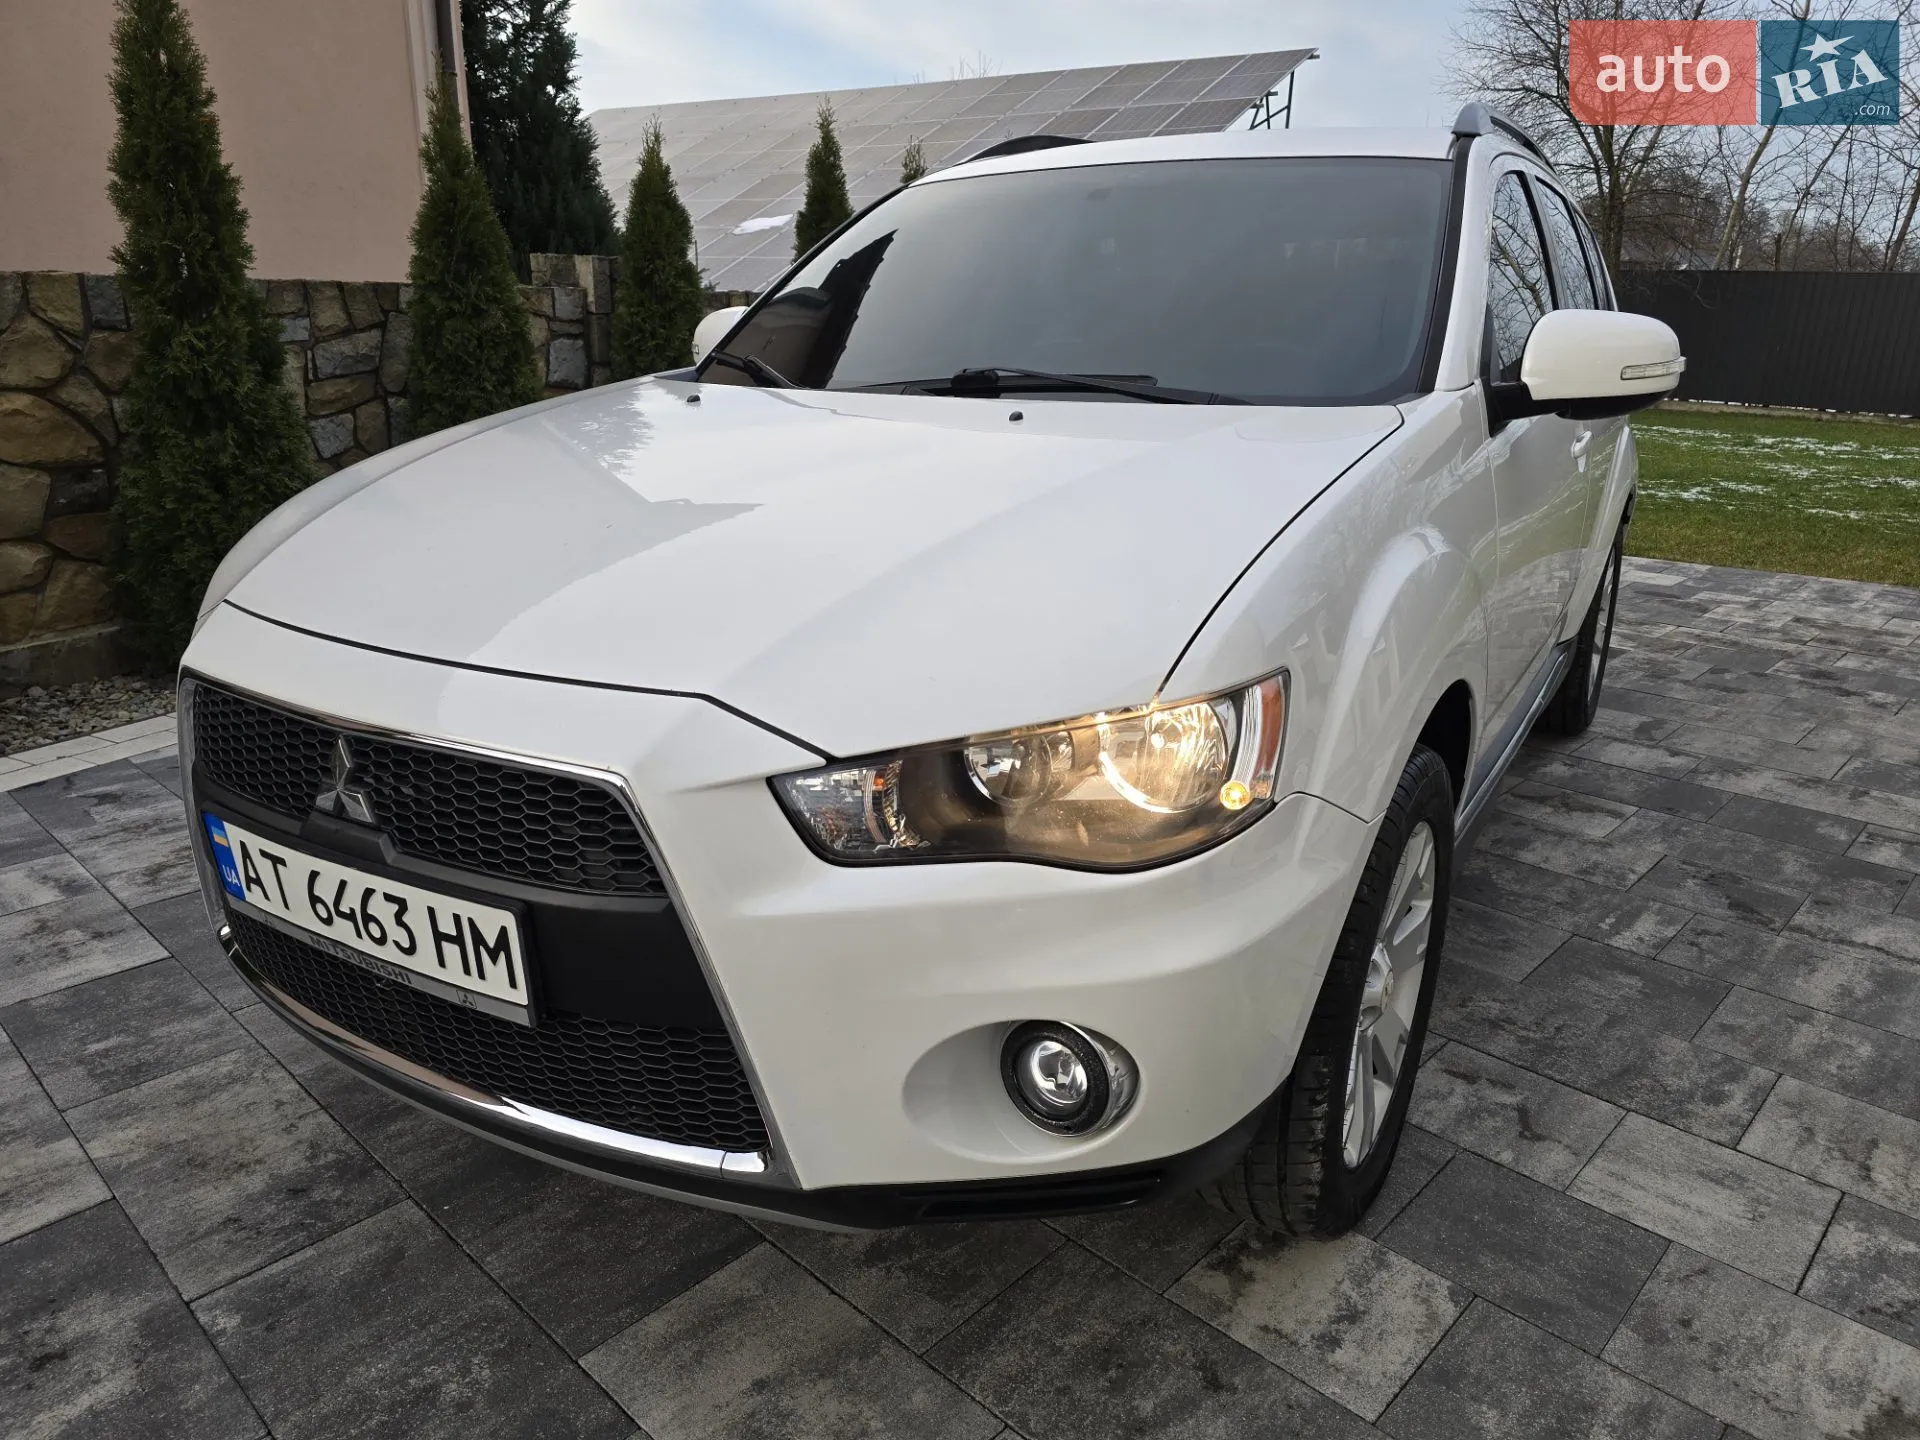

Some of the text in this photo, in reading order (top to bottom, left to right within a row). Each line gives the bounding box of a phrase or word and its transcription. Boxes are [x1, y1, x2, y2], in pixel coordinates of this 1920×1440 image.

[223, 865, 240, 888] UA
[240, 841, 518, 990] AT 6463 HM
[308, 935, 413, 985] MITSUBISHI
